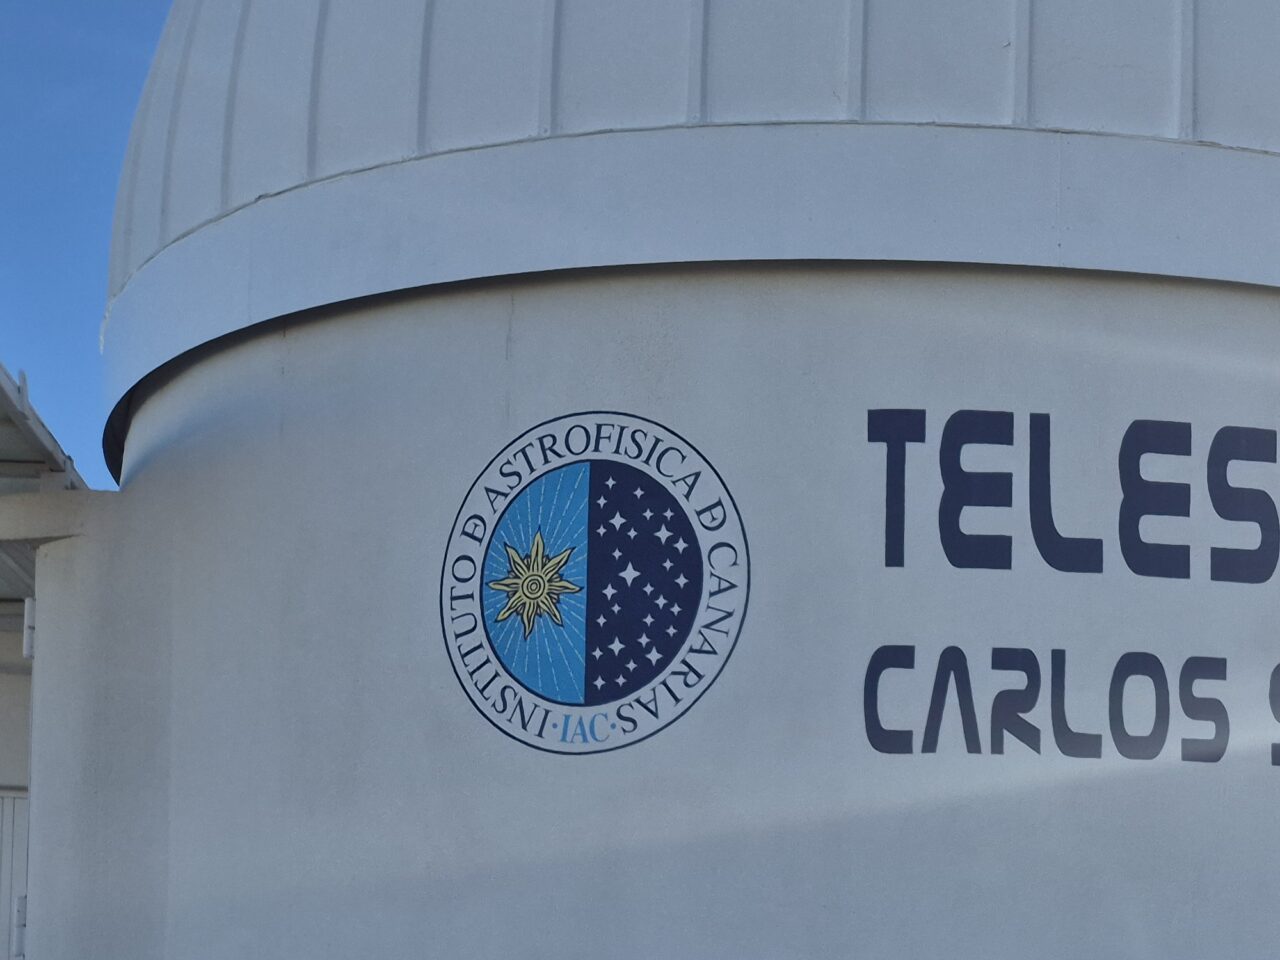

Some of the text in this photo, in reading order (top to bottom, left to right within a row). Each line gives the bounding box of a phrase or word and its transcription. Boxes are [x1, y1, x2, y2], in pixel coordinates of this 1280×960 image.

[483, 422, 703, 514] ASTROFISICA
[450, 554, 553, 739] INSTITUTO
[616, 541, 740, 736] CANARIAS
[559, 712, 611, 744] IAC
[863, 644, 1230, 763] CARLOS
